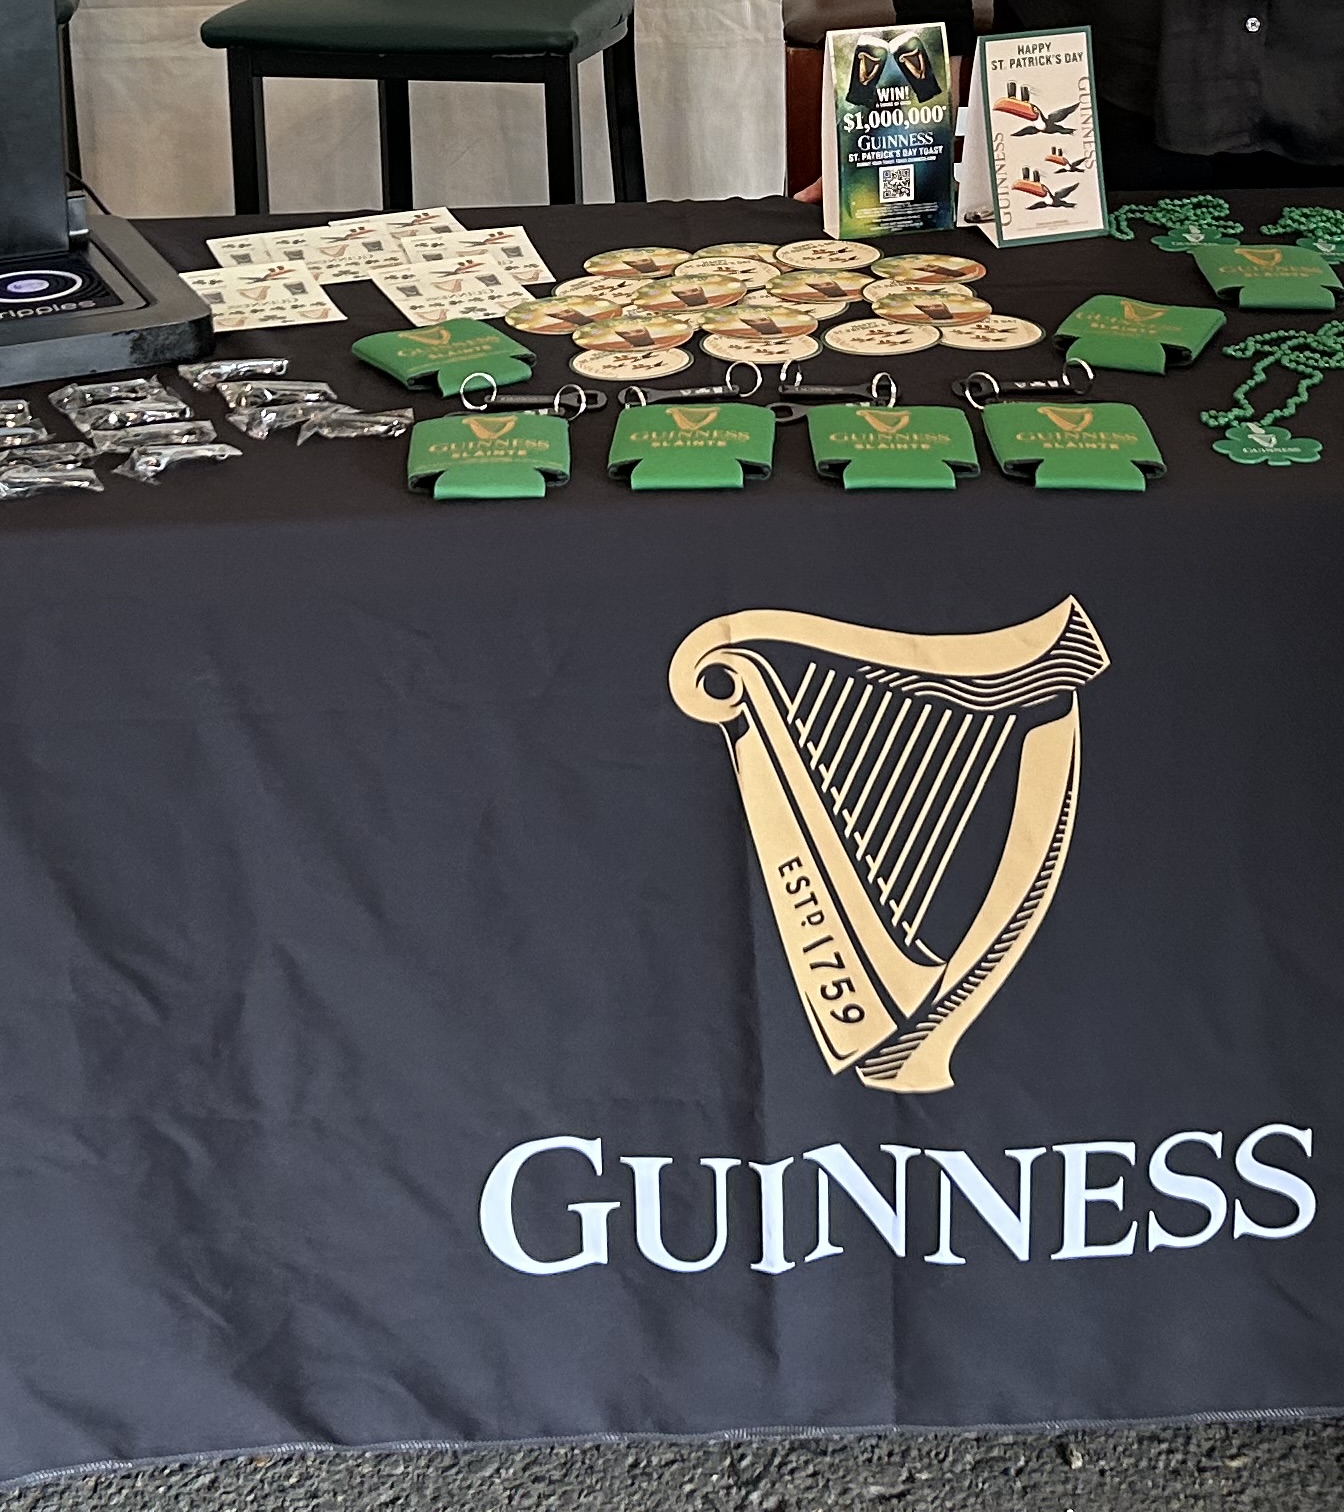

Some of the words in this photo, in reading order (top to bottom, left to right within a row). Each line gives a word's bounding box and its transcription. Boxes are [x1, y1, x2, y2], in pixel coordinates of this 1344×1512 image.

[1017, 42, 1052, 56] HAPPY
[1009, 54, 1062, 70] PATRICK'S
[1064, 51, 1084, 64] DAY
[876, 85, 910, 102] WIN!
[1077, 76, 1097, 170] GUINNESS
[857, 131, 934, 151] GUINNESS
[902, 148, 918, 158] DAY
[919, 145, 944, 156] TOAST
[993, 132, 1013, 227] GUINNESS
[629, 429, 751, 442] GUINNESS
[829, 433, 951, 443] GUINNESS
[1016, 431, 1138, 443] GUINNESS
[428, 438, 550, 454] GUINNESS
[802, 934, 866, 1024] 1759
[478, 1121, 1319, 1276] GUINNESS
